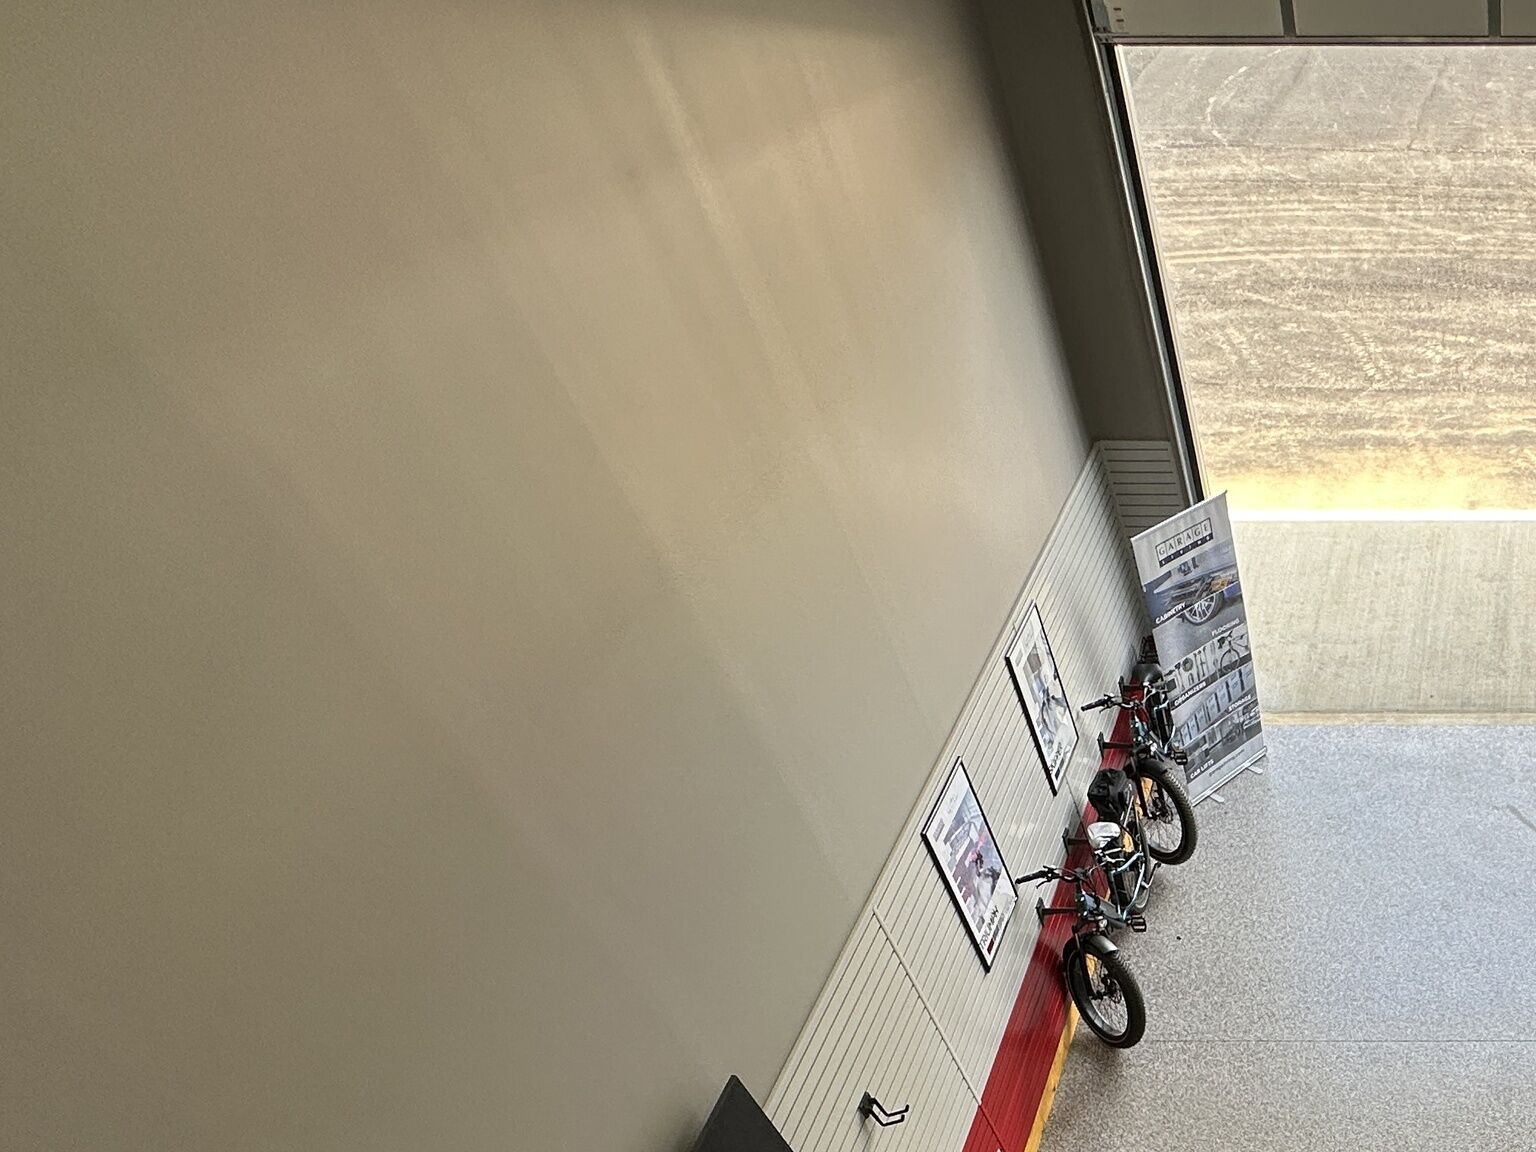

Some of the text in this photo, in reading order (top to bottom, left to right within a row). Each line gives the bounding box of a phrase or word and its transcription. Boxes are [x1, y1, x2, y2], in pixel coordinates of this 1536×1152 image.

[1158, 521, 1210, 556] GARAGE
[1154, 600, 1187, 624] CABINETRY
[1173, 680, 1207, 706] ORGANIZERS
[1227, 693, 1251, 713] STORAGE
[1189, 758, 1215, 780] CAR LIFTS
